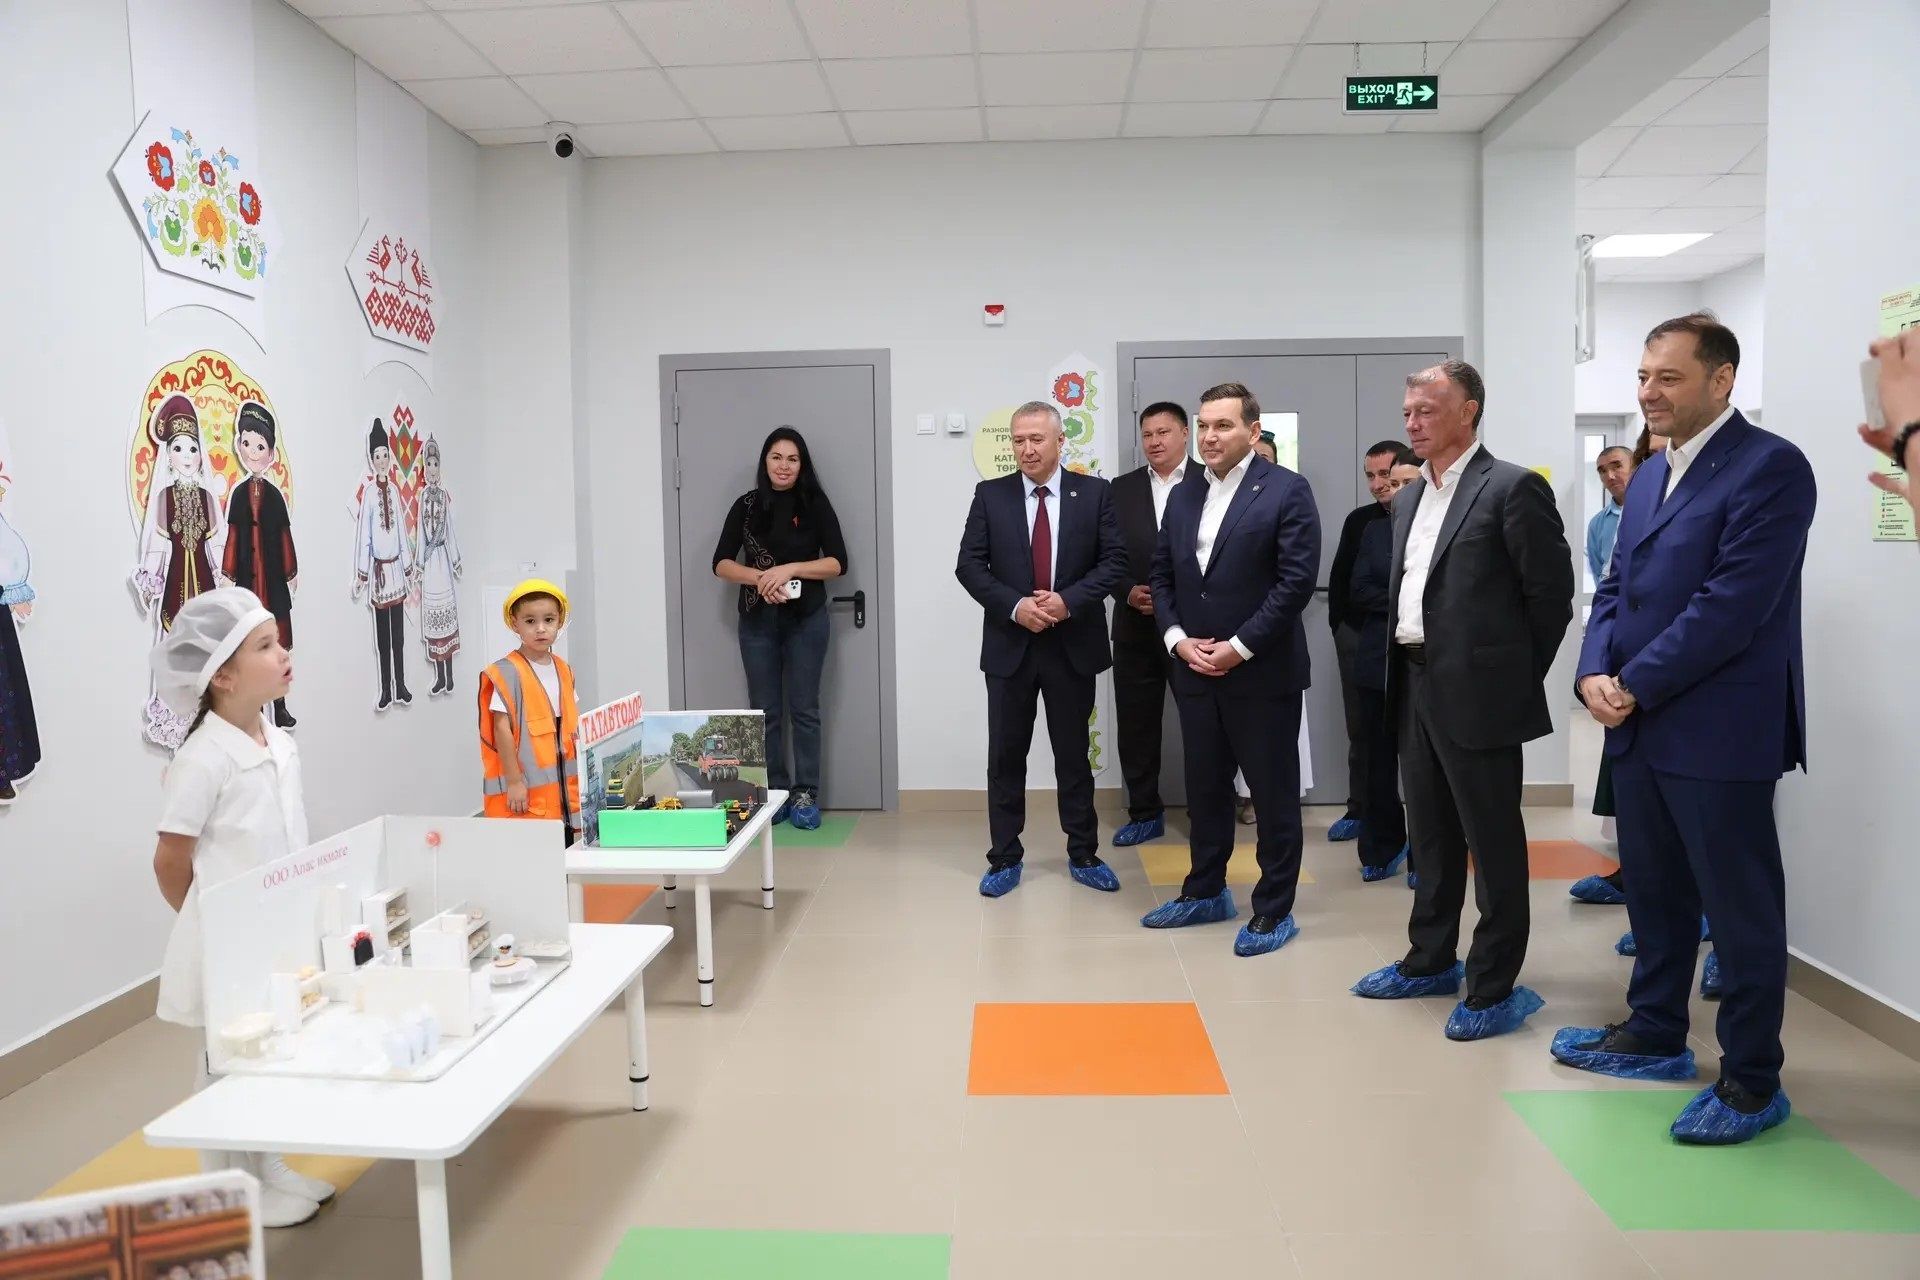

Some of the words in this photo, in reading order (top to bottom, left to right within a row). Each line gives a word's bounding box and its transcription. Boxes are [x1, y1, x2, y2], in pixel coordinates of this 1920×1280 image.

[1348, 84, 1395, 95] ВЫХОД
[1357, 94, 1386, 104] EXIT
[582, 695, 642, 744] ТАТАВТОДОР
[263, 867, 288, 889] ООО
